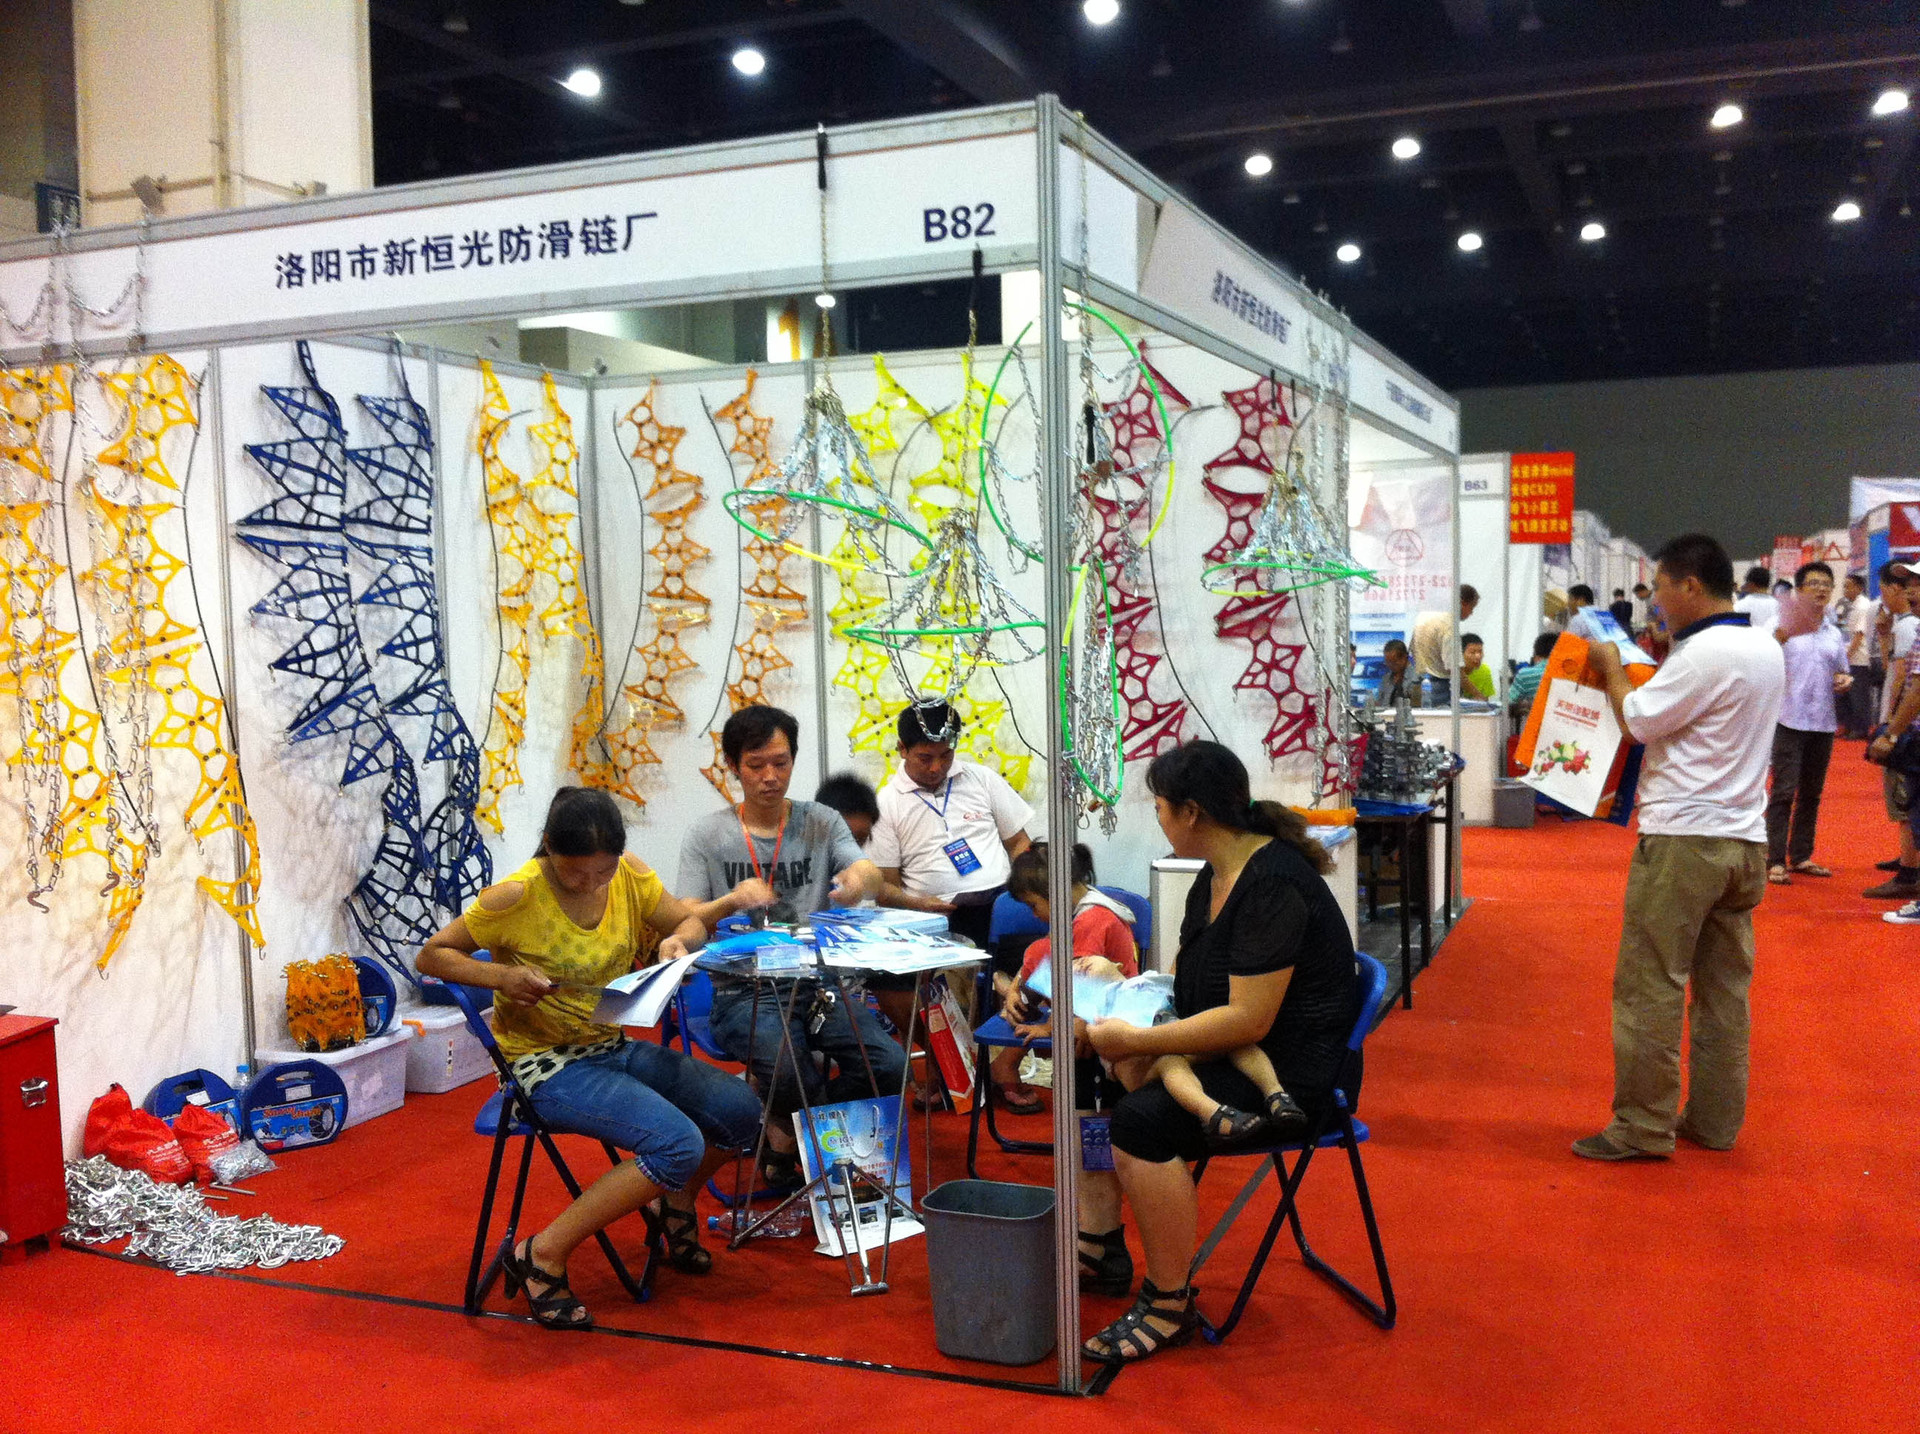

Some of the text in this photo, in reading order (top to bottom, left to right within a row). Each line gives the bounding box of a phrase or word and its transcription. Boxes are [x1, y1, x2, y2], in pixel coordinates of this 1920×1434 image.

[923, 202, 996, 243] B82
[275, 211, 659, 290] 洛阳市新恒光防滑链厂
[1464, 480, 1488, 491] B63
